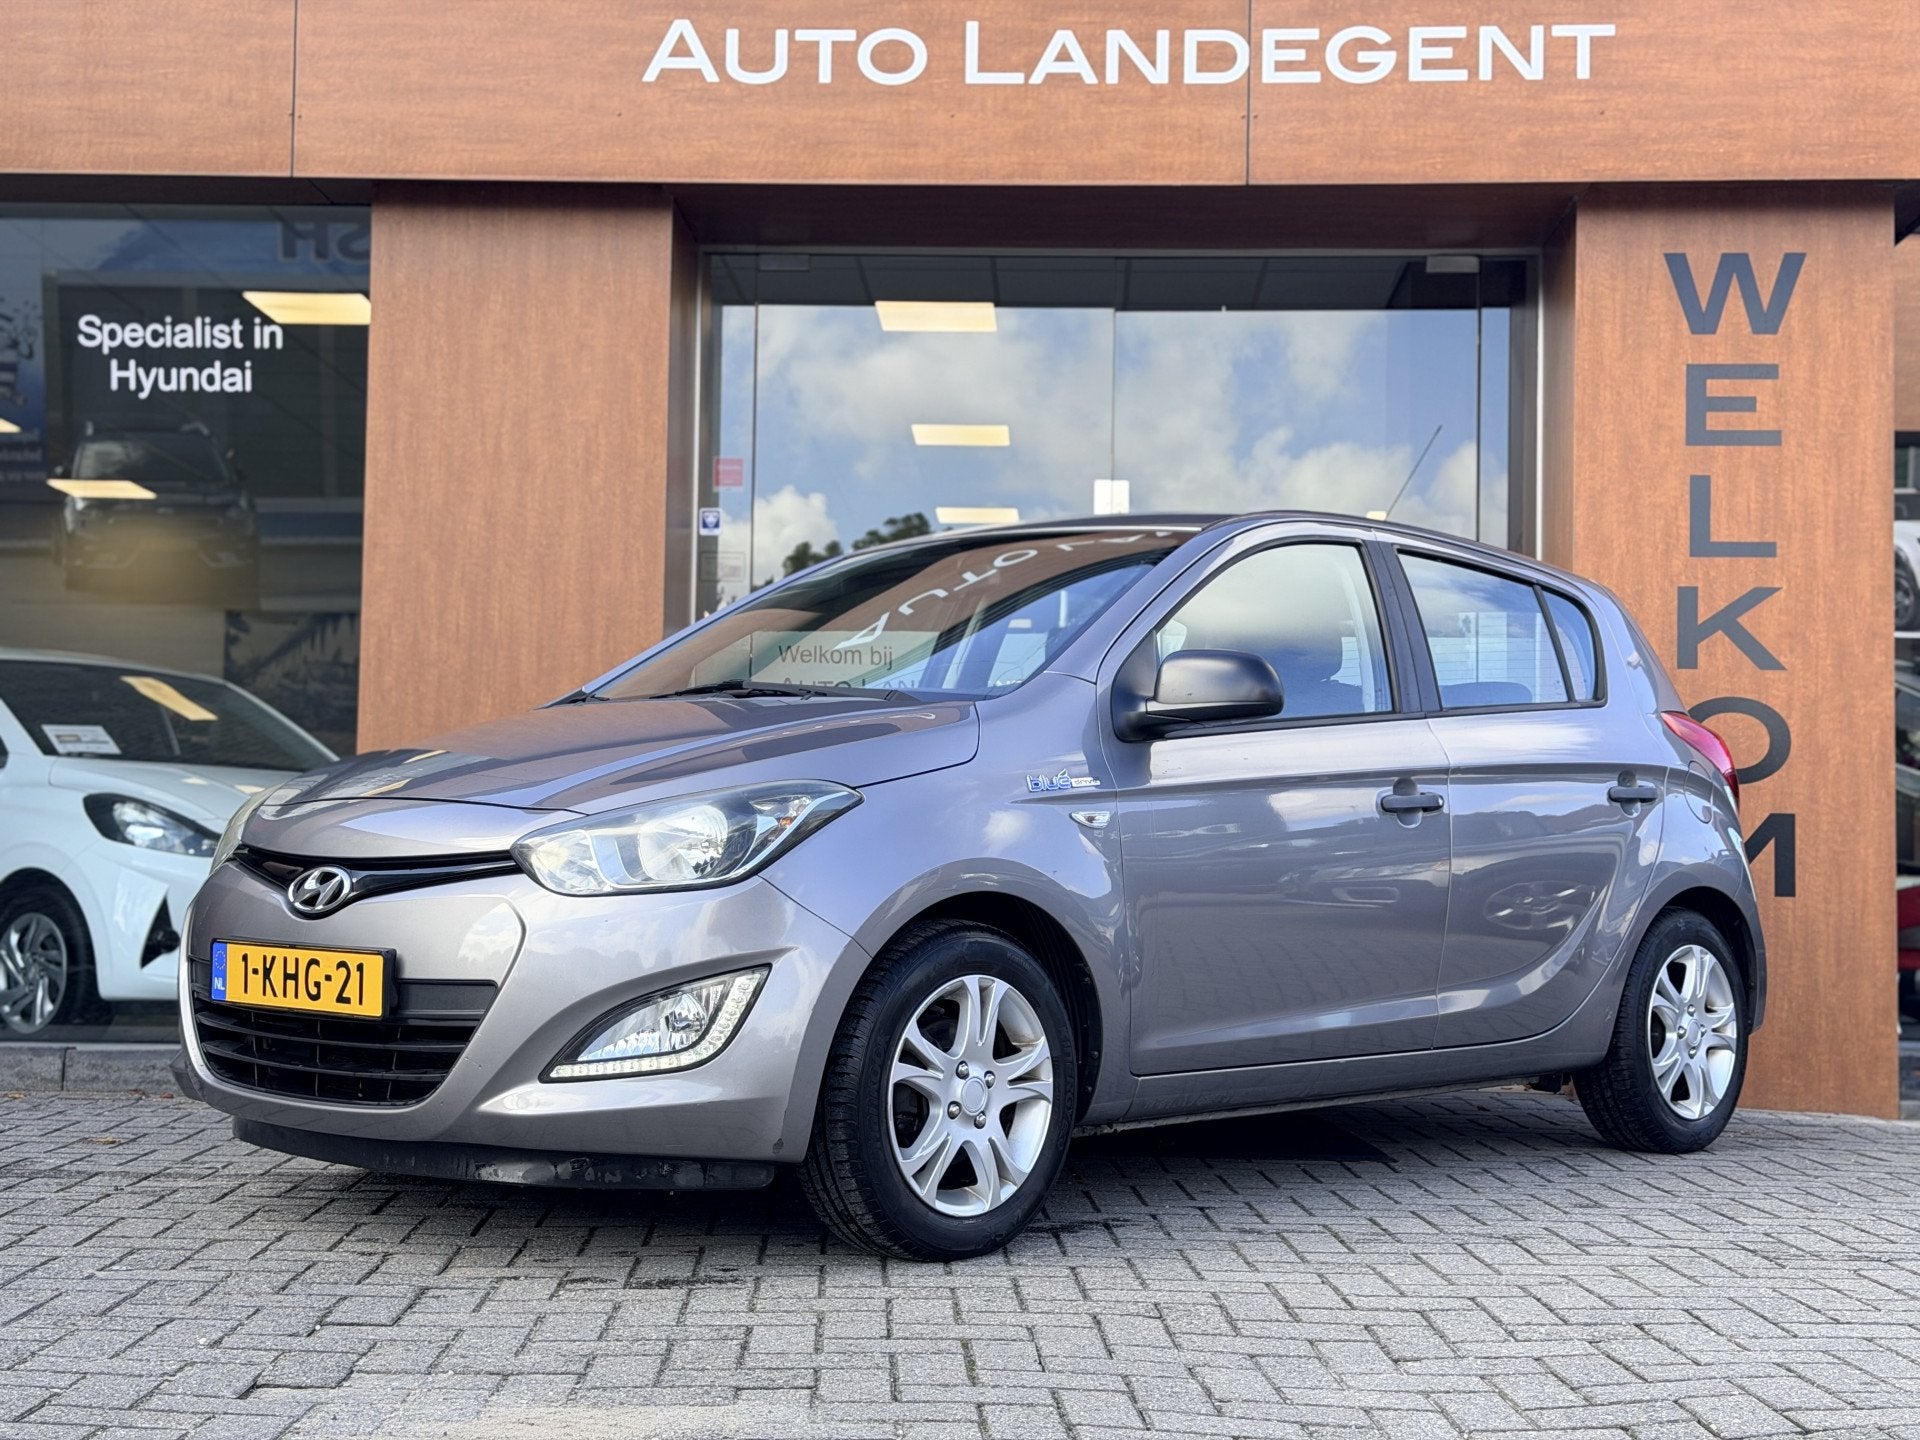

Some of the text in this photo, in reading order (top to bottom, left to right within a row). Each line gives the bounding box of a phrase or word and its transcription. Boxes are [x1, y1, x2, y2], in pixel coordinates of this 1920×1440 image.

[642, 19, 1617, 87] AUTO LANDEGENT
[77, 314, 284, 355] Specialist in
[110, 358, 253, 400] Hyundai
[778, 644, 893, 671] Welkom bij
[214, 976, 225, 991] NL
[241, 952, 365, 1006] 1-KHG-21
